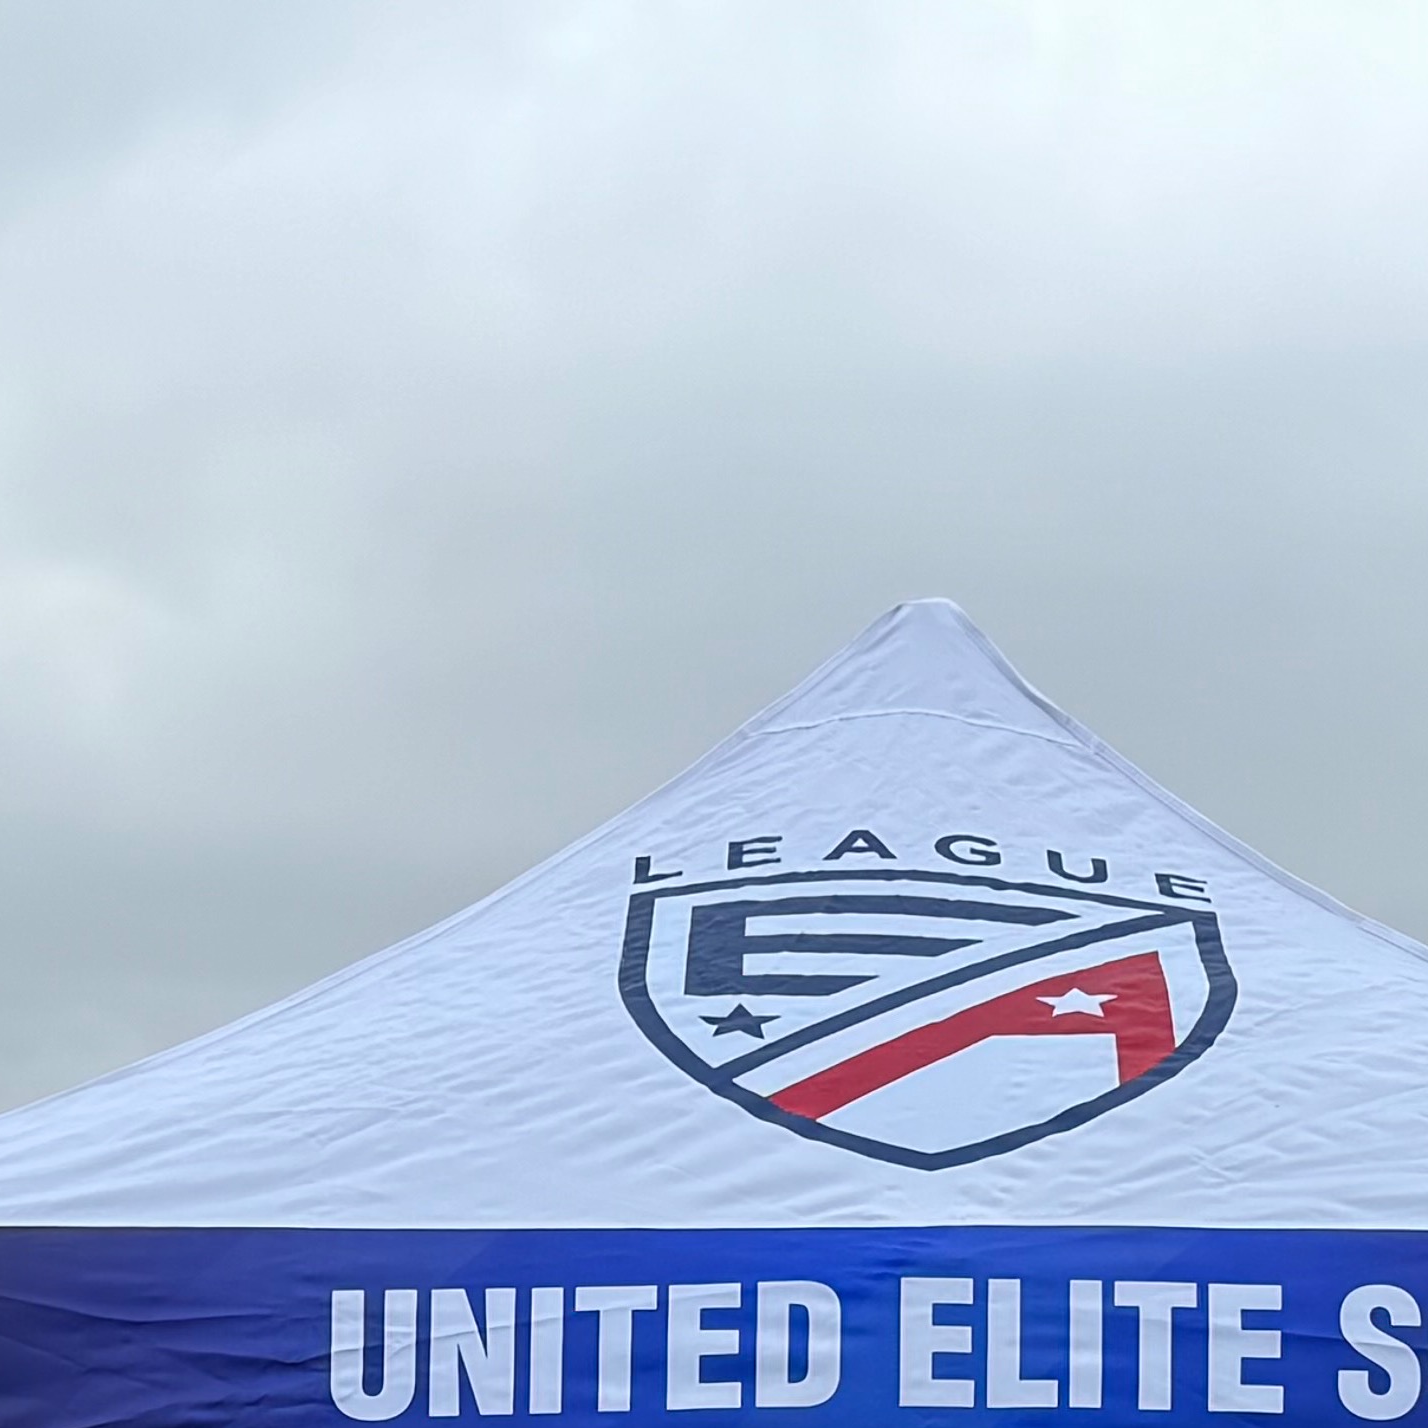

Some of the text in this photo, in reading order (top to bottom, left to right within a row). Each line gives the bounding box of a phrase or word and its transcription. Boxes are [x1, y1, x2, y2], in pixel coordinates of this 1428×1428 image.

[633, 829, 1212, 904] LEAGUE
[330, 1280, 843, 1422] UNITED
[897, 1275, 1285, 1415] ELITE
